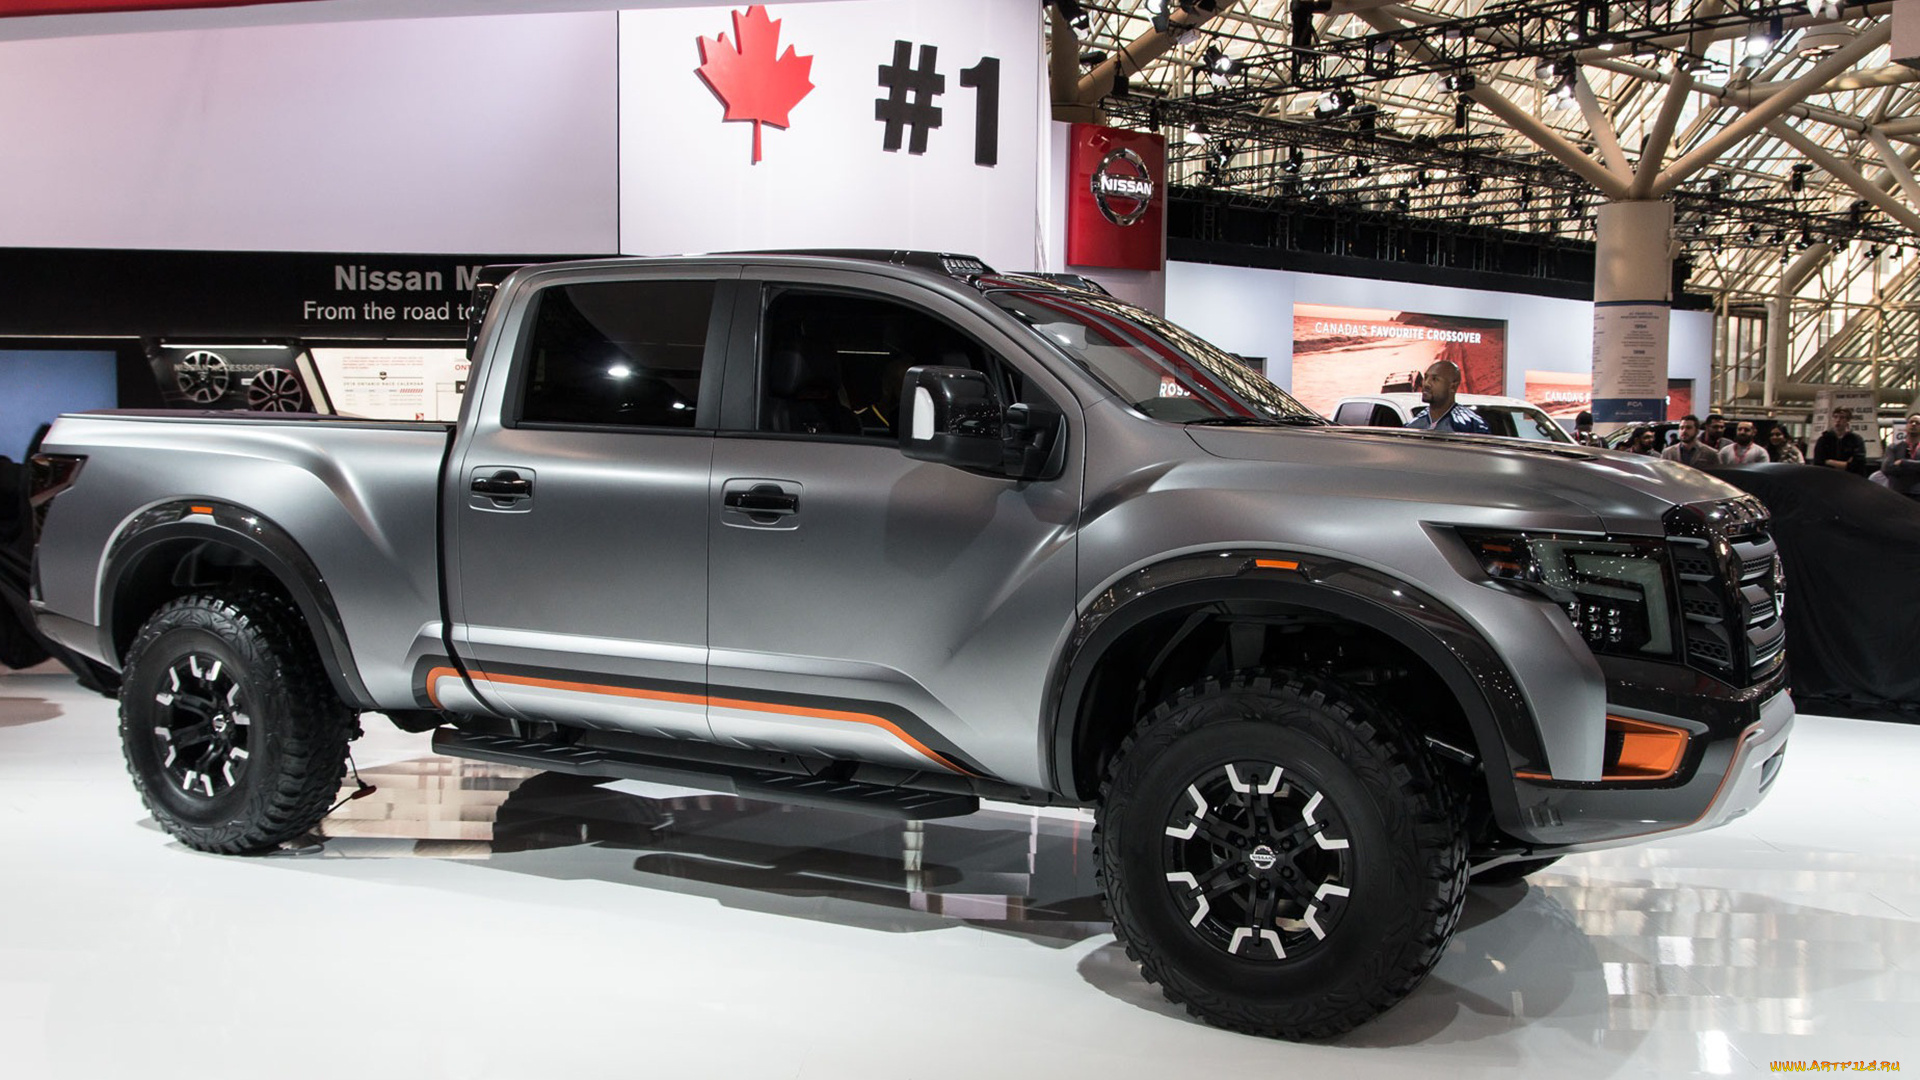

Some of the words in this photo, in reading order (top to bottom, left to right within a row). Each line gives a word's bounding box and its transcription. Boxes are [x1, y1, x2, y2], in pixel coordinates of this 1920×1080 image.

[875, 40, 1000, 167] #1
[1101, 176, 1152, 195] NISSAN
[335, 265, 443, 291] Nissan
[304, 301, 356, 320] From
[363, 301, 396, 320] the
[403, 301, 450, 320] road
[1315, 321, 1368, 337] CANADA'S
[1371, 325, 1424, 340] FAVOURITE
[1427, 330, 1481, 344] CROSSOVER
